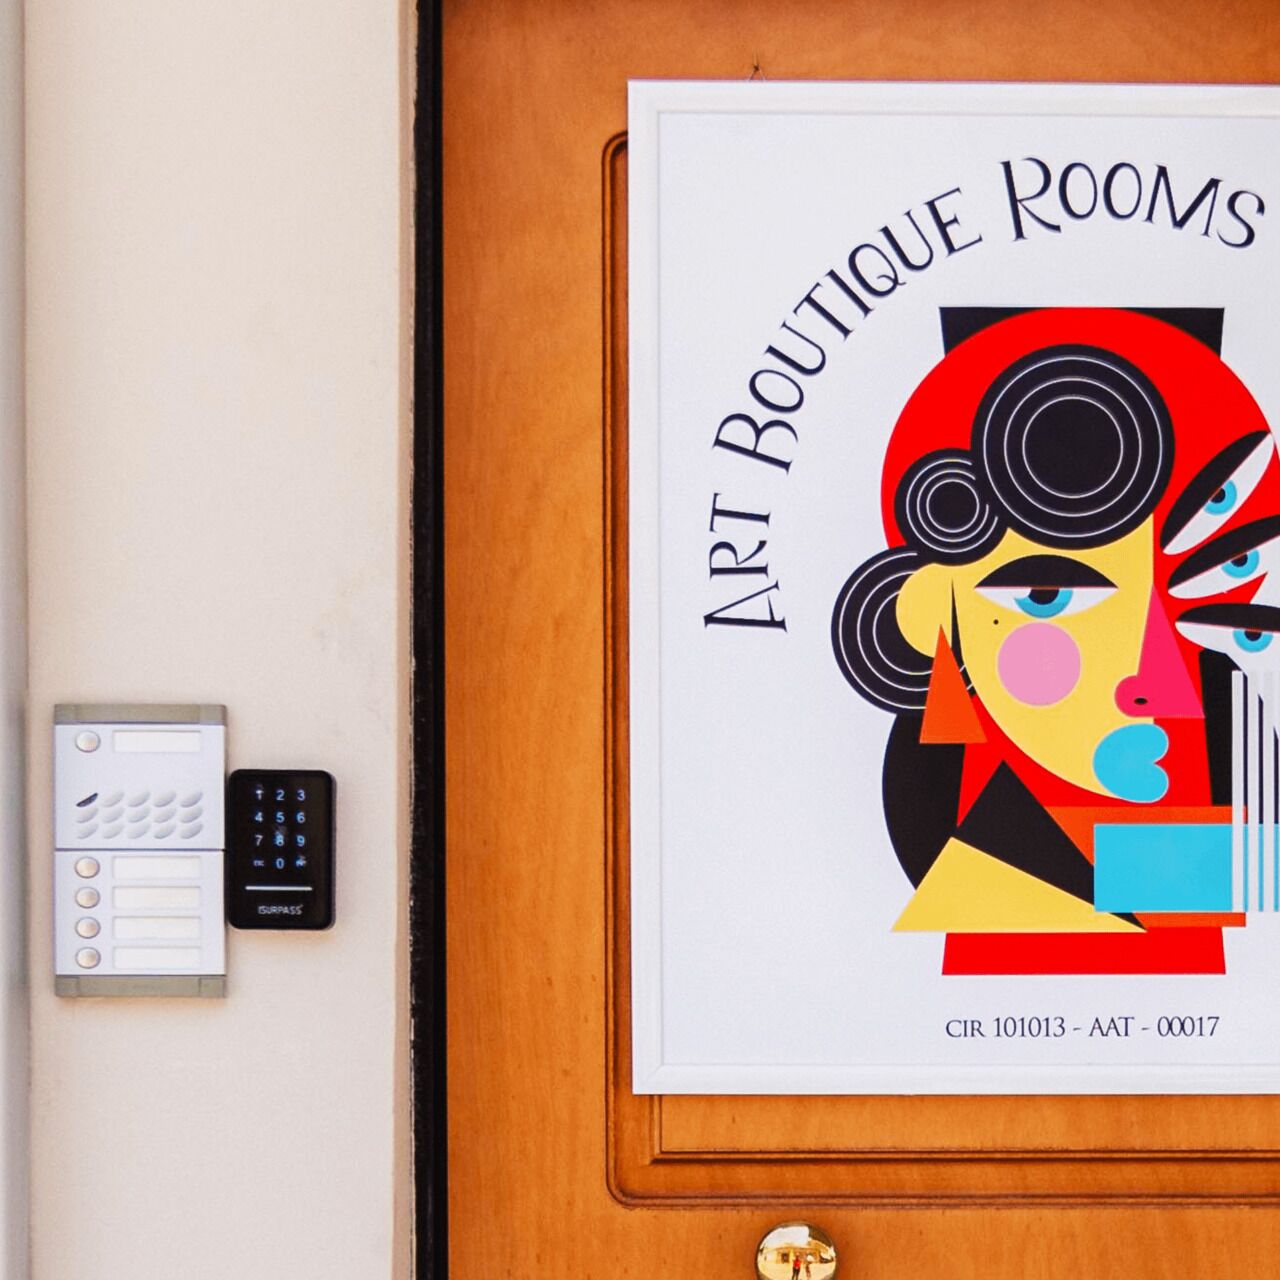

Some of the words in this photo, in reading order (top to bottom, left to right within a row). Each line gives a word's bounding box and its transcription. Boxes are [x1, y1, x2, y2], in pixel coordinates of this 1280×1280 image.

[1000, 156, 1267, 251] ROOMS
[711, 186, 984, 474] BOUTIQUE
[703, 492, 788, 633] ART
[254, 788, 264, 800] 1
[276, 789, 285, 801] 2
[296, 789, 306, 801] 3
[254, 811, 264, 822] 4
[275, 811, 285, 823] 5
[296, 811, 306, 824] 6
[254, 834, 264, 846] 7
[275, 834, 285, 847] 8
[296, 834, 306, 847] 9
[275, 858, 285, 870] 0
[945, 1020, 985, 1038] CIR
[994, 1016, 1066, 1038] 101013
[1088, 1016, 1135, 1038] AAT
[1157, 1016, 1220, 1038] 00017
